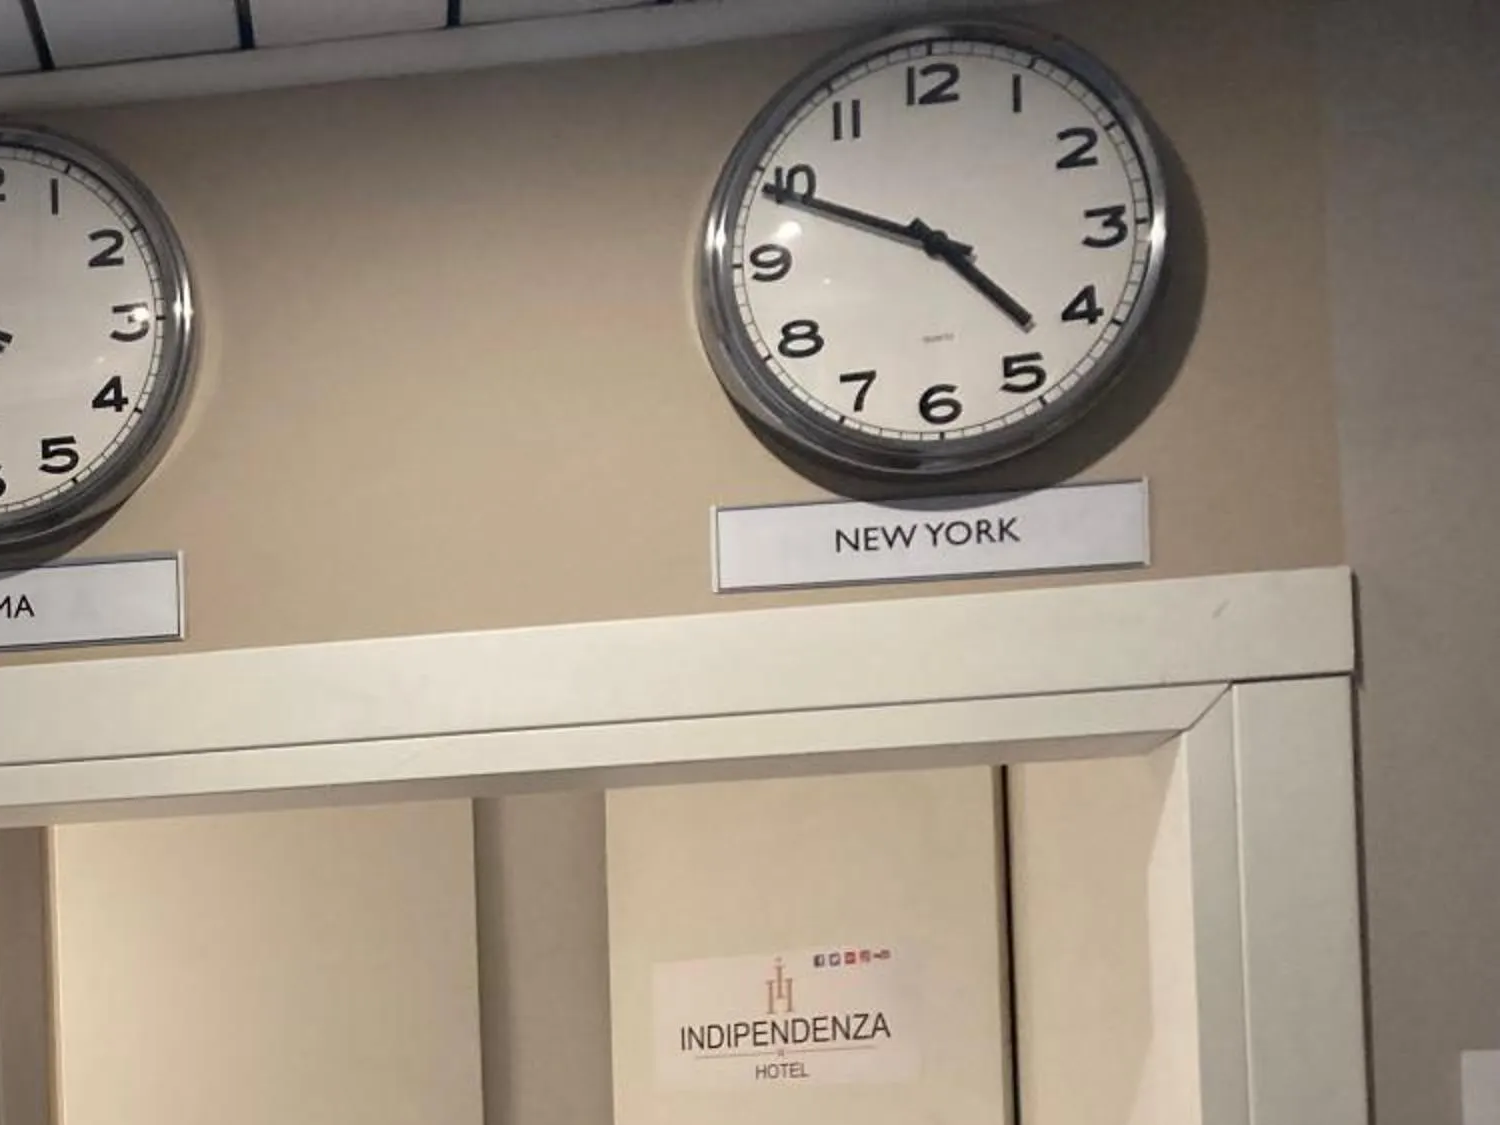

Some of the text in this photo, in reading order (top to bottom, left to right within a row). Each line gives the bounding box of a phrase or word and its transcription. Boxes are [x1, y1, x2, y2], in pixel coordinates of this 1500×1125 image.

[906, 63, 960, 106] 12
[1012, 74, 1022, 113] 1
[833, 100, 861, 140] 11
[1056, 128, 1098, 169] 2
[51, 178, 59, 215] 1
[775, 164, 816, 204] 10
[1082, 204, 1127, 247] 3
[88, 229, 124, 267] 2
[749, 244, 792, 282] 9
[110, 303, 150, 342] 3
[1061, 286, 1104, 324] 4
[777, 320, 825, 358] 8
[839, 370, 876, 412] 7
[1001, 353, 1046, 392] 5
[92, 376, 128, 413] 4
[918, 385, 962, 424] 6
[39, 437, 79, 474] 5
[835, 517, 1020, 553] NEW YORK
[681, 1012, 891, 1051] INDIPENDENZA
[755, 1063, 809, 1079] HOTEL
